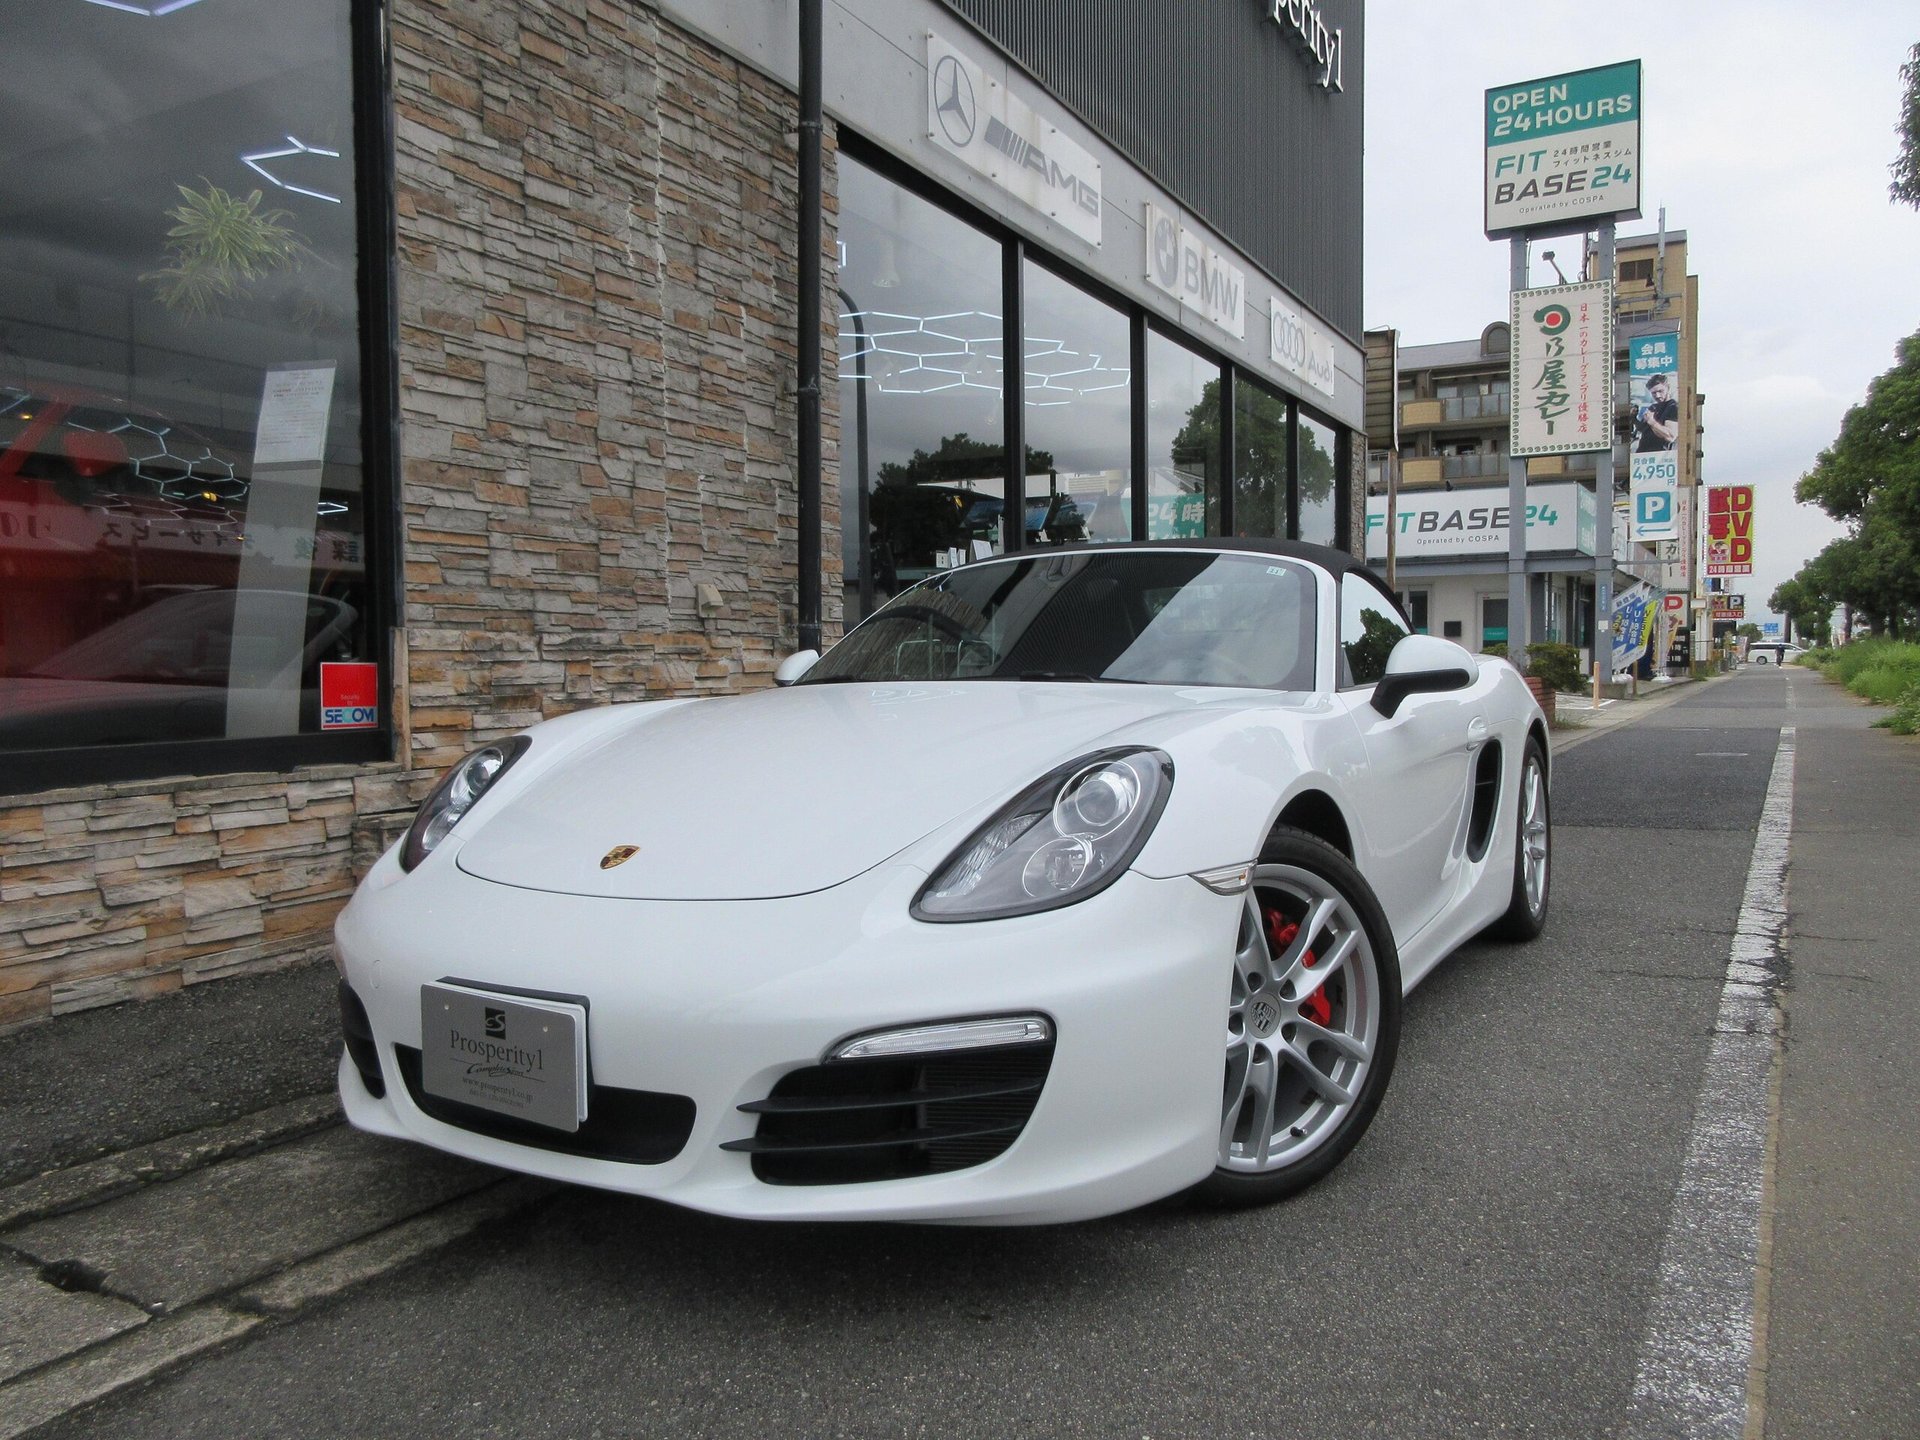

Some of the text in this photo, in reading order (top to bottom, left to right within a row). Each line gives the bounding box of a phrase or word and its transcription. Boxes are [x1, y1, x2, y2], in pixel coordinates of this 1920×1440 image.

[1493, 83, 1567, 114] OPEN
[1553, 140, 1612, 158] 24時間営業
[1553, 148, 1632, 168] フィットネスジム
[1494, 150, 1548, 178] FIT
[1519, 194, 1605, 214] Operated by COSPA
[1184, 248, 1239, 321] BMW
[1641, 341, 1666, 356] 会員
[1307, 357, 1334, 384] Audi
[1632, 464, 1676, 480] 4,950
[1645, 496, 1665, 520] P
[1730, 486, 1752, 563] DVD
[1417, 537, 1453, 545] Operated
[1468, 535, 1500, 543] COSPA
[325, 708, 374, 723] SECOM
